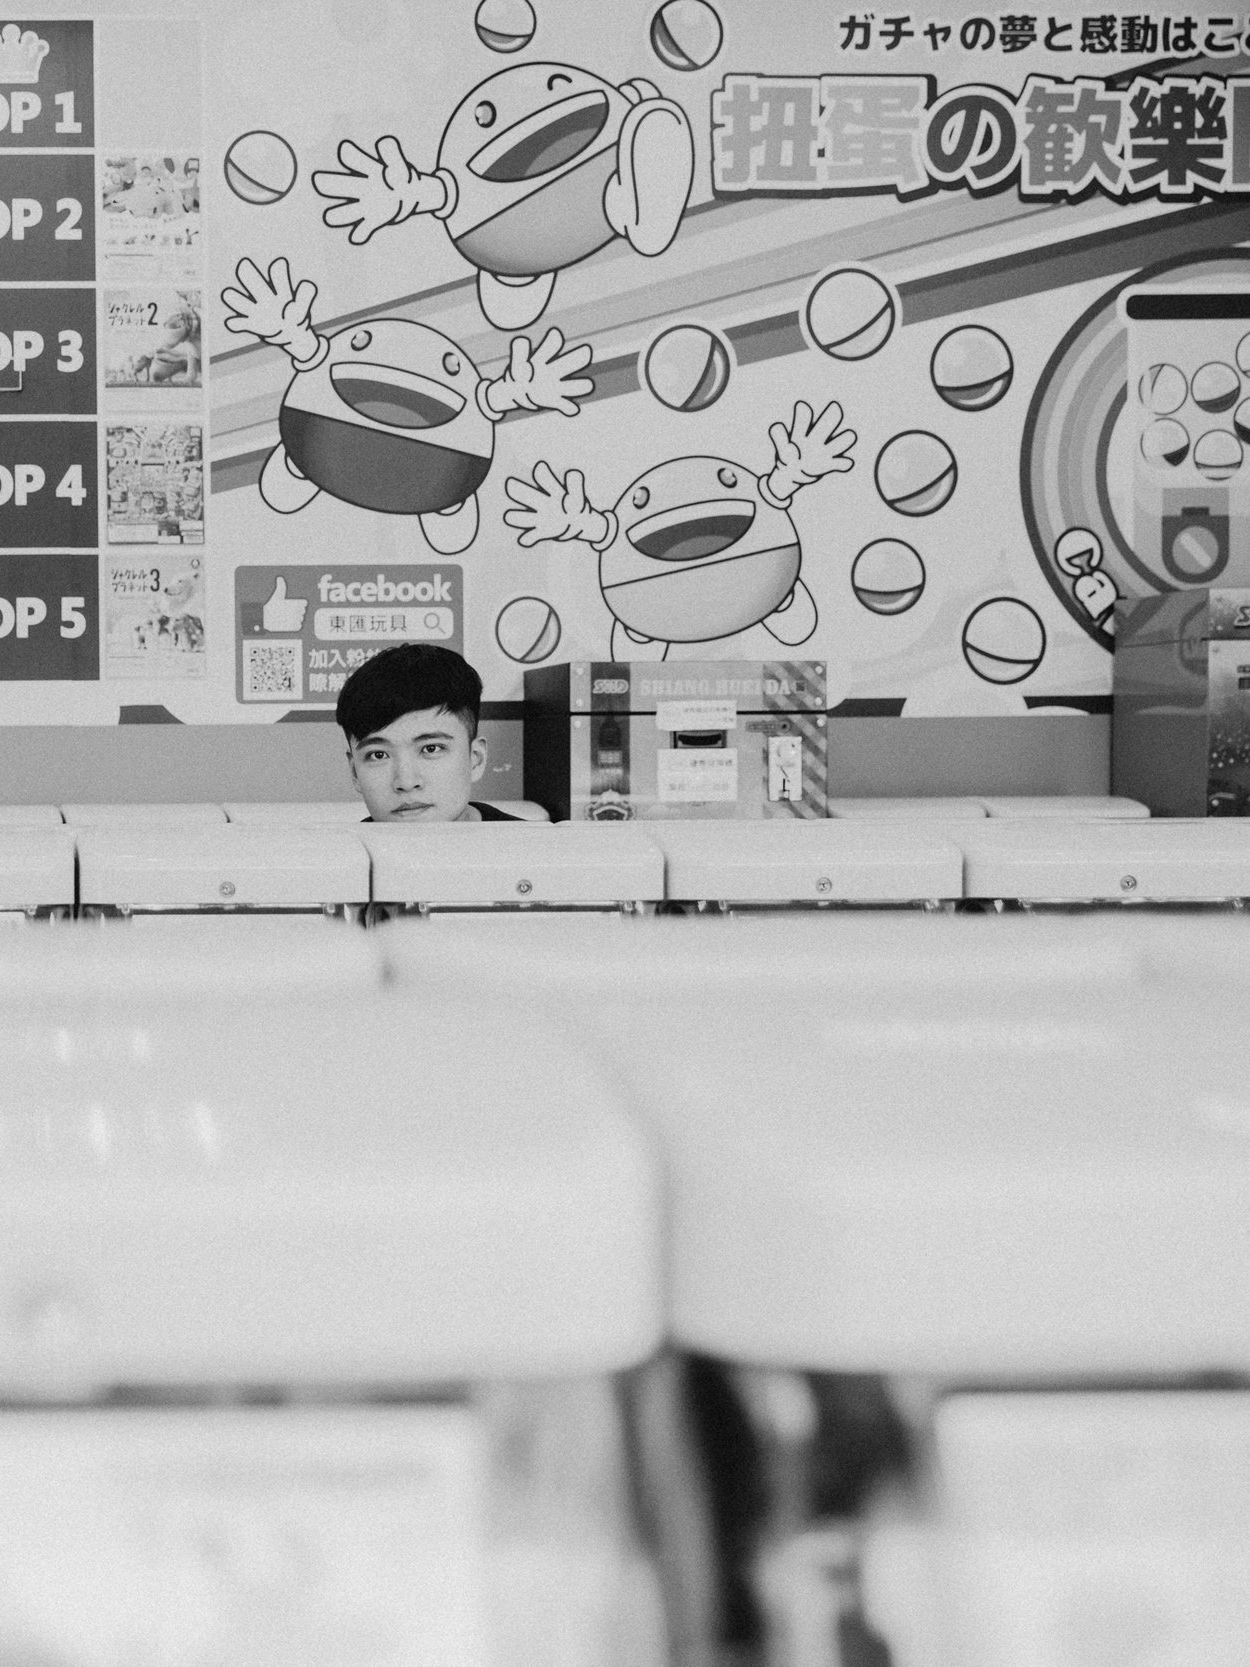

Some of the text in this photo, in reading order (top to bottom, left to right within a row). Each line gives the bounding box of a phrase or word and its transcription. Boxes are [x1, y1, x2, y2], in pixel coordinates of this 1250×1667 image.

[838, 14, 1250, 54] ガチャの夢と感動はこ
[54, 90, 83, 134] 1
[719, 82, 1250, 190] 扭蛋の歓樂
[54, 197, 83, 241] 2
[147, 302, 158, 326] 2
[56, 328, 85, 373] 3
[55, 464, 88, 507] 4
[149, 568, 161, 592] 3
[317, 573, 453, 602] facebook
[59, 595, 87, 640] 5
